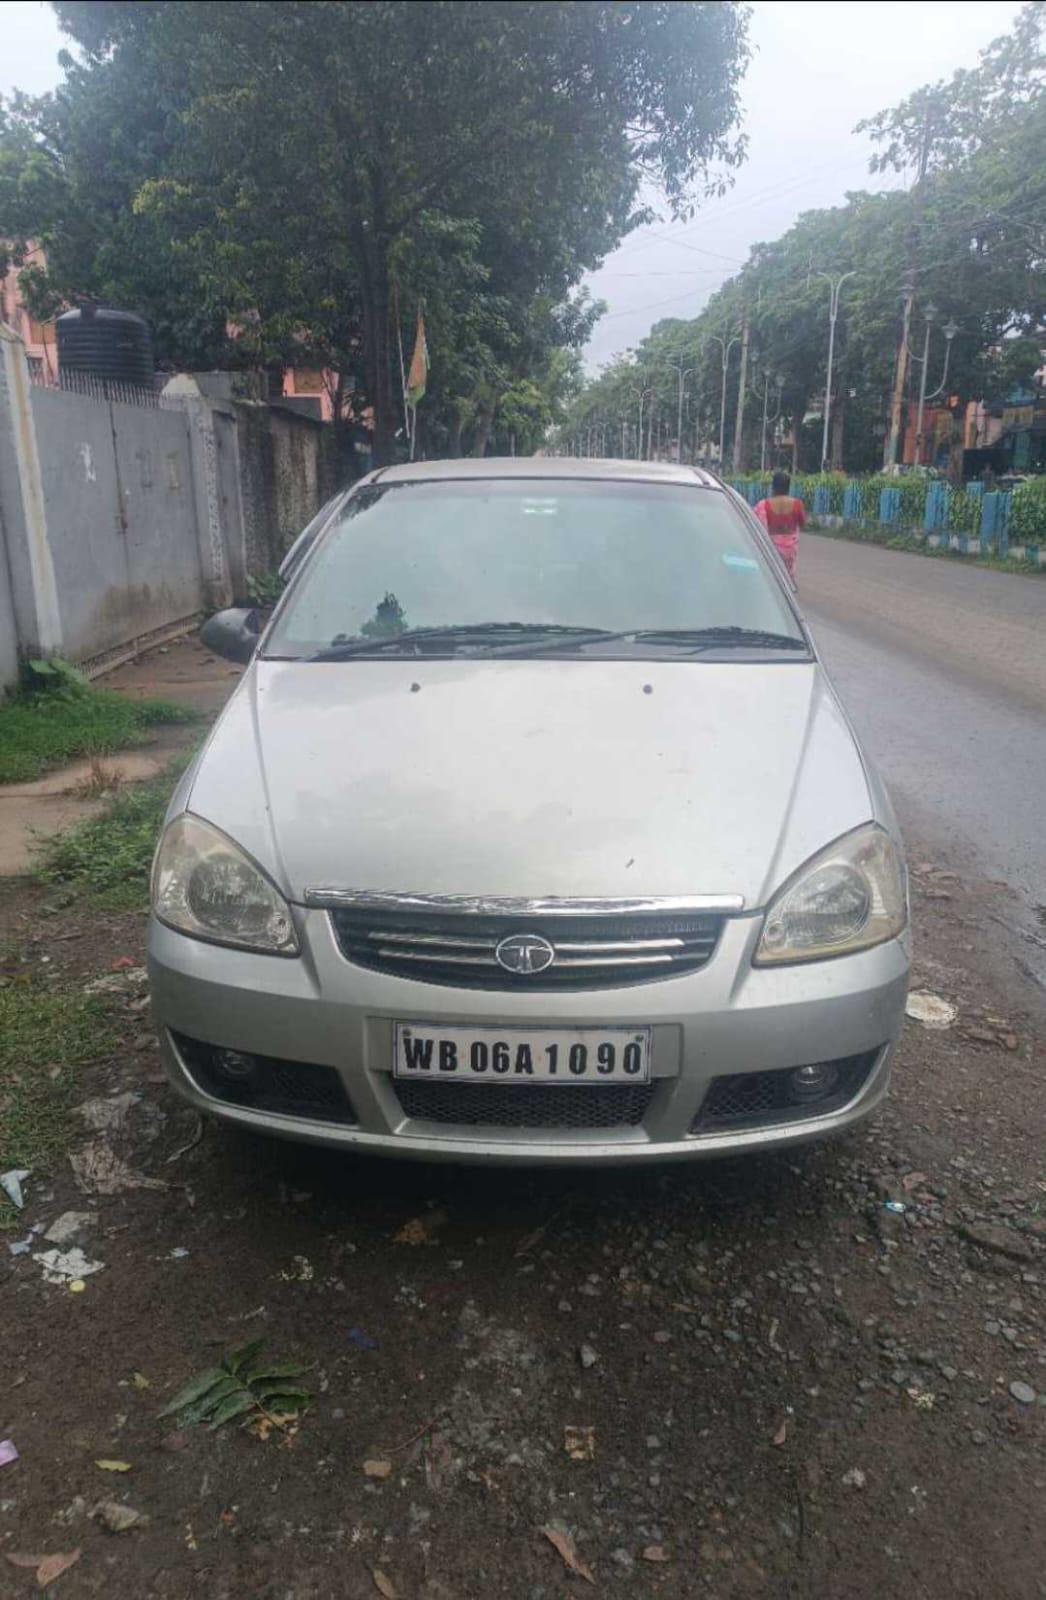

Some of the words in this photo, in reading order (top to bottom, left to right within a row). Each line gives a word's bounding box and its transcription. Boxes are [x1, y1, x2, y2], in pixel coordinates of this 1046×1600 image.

[403, 1037, 458, 1071] WB
[470, 1041, 534, 1075] 06A
[545, 1042, 642, 1075] 1090
